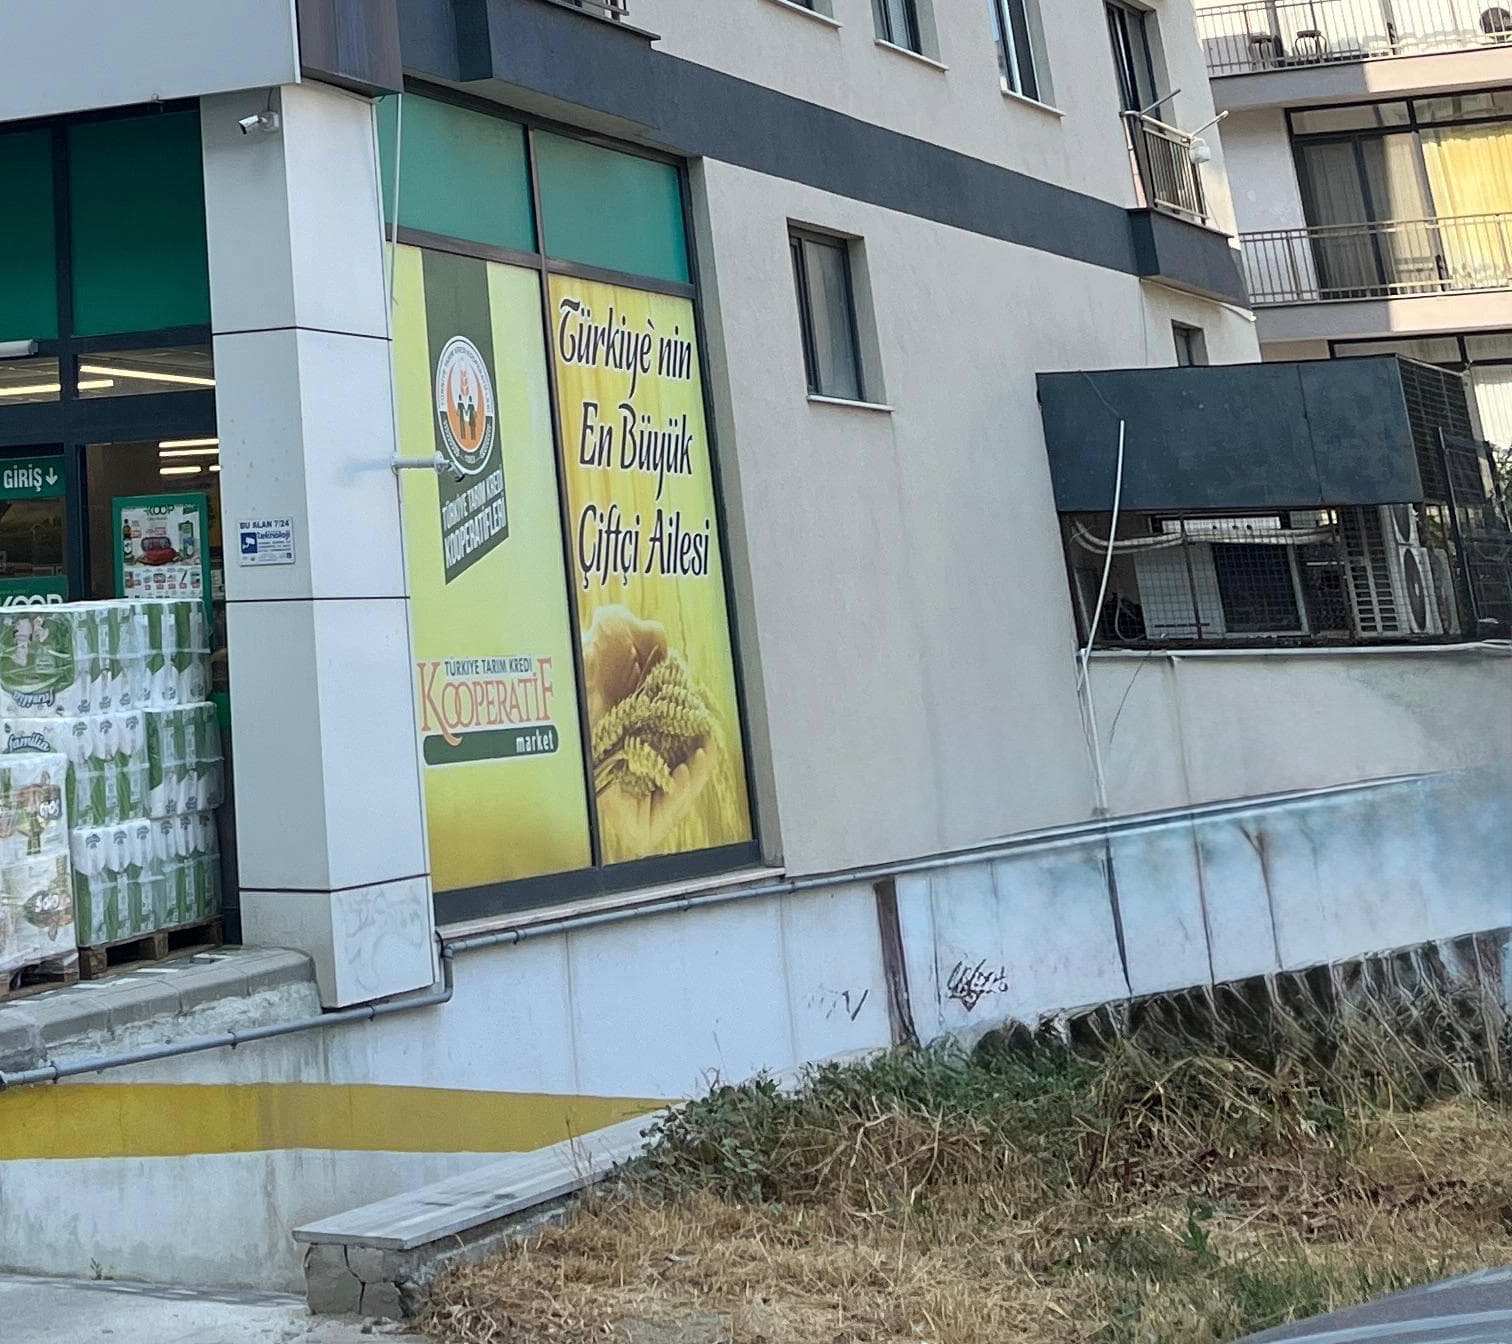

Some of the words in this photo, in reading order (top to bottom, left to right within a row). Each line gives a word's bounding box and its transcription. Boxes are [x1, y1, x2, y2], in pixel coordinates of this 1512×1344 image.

[3, 464, 42, 491] GİRİŞ
[579, 401, 613, 467] En
[618, 403, 692, 501] Büyük
[442, 494, 469, 531] TÜRKİYE
[467, 480, 487, 513] TARIM
[485, 464, 504, 500] KREDİ
[444, 492, 507, 569] KOOPERATİFLERİ
[578, 504, 641, 589] Çiftçi
[645, 508, 709, 575] Ailesi
[444, 655, 479, 676] TÜRKİYE
[481, 658, 506, 674] TARIM
[509, 655, 533, 673] KREDİ
[416, 656, 553, 747] KOOPERATİF
[7, 731, 51, 752] familia
[516, 729, 555, 753] market
